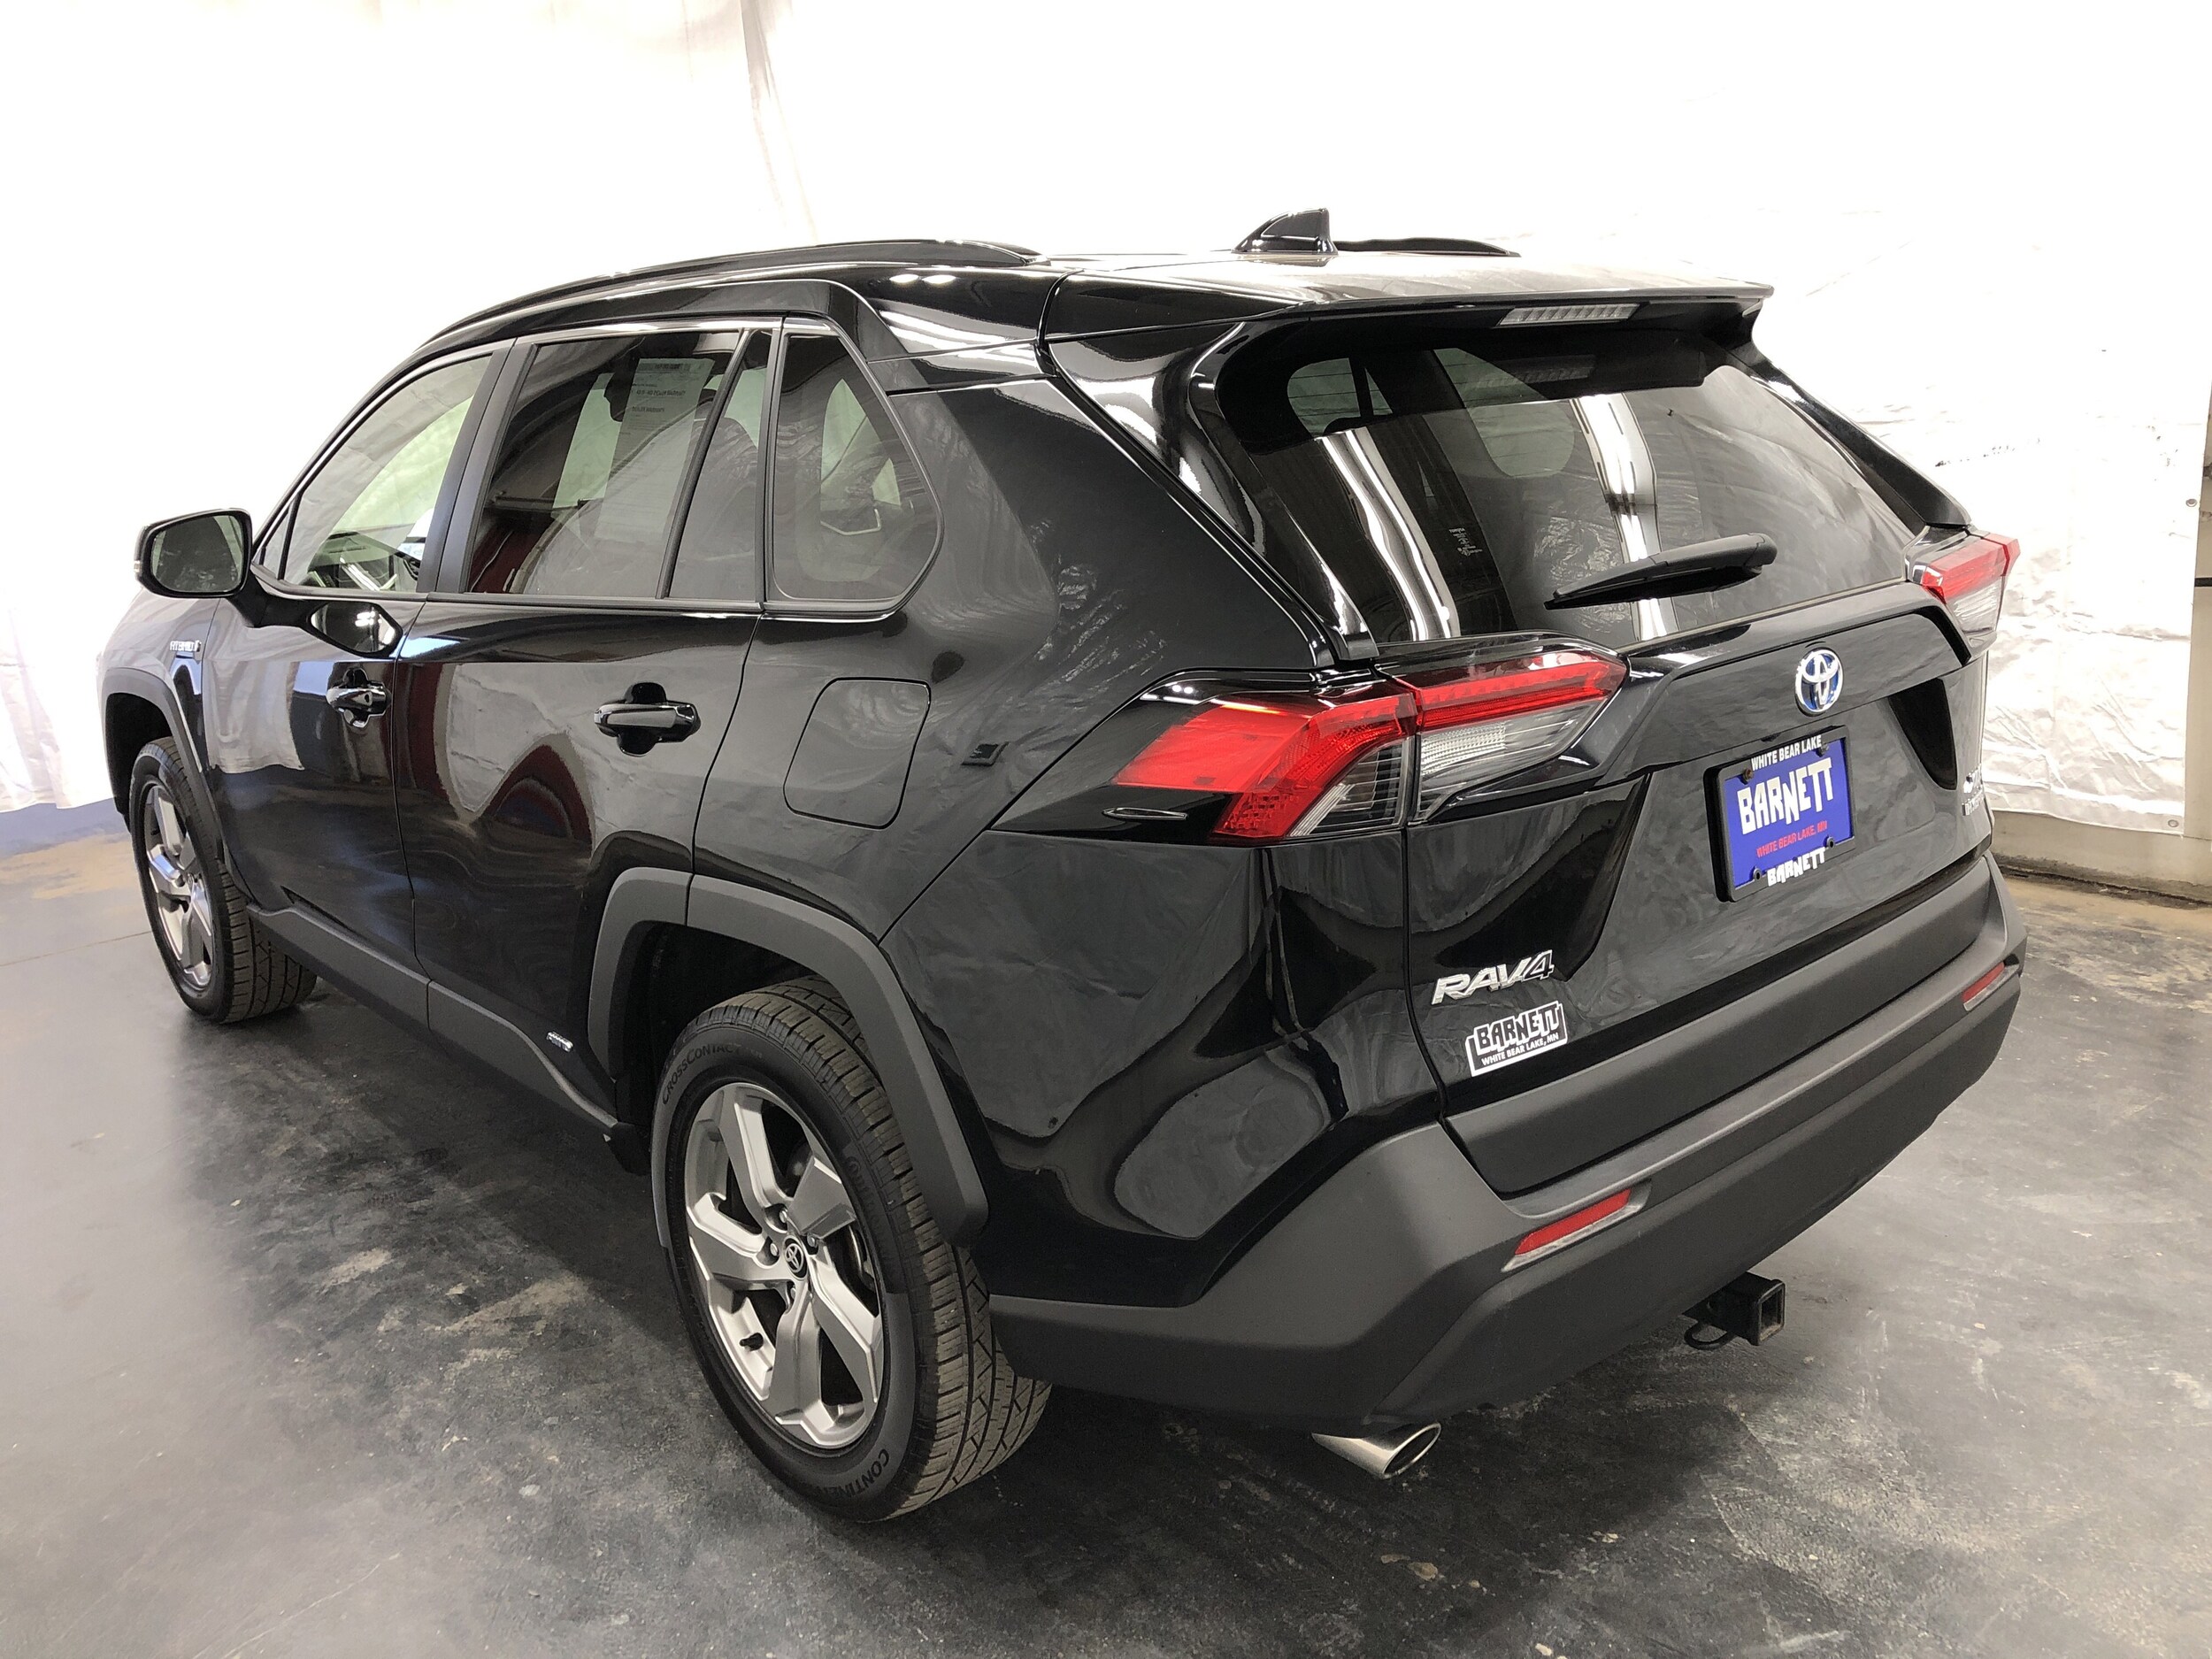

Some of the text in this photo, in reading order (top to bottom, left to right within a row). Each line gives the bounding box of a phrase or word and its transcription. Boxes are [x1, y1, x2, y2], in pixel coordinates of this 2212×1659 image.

[1751, 734, 1822, 771] WHITE BEAR LAKE
[1737, 757, 1833, 835] BARNETT
[1756, 841, 1778, 857] WHITE
[1778, 833, 1797, 849] BEAR
[1816, 820, 1827, 833] MN
[1766, 847, 1826, 887] BARNETT
[1431, 949, 1555, 1006] RAV4
[1475, 1002, 1559, 1052] BARNETT
[1481, 1032, 1559, 1066] WHITE BEAR LAKE, MN
